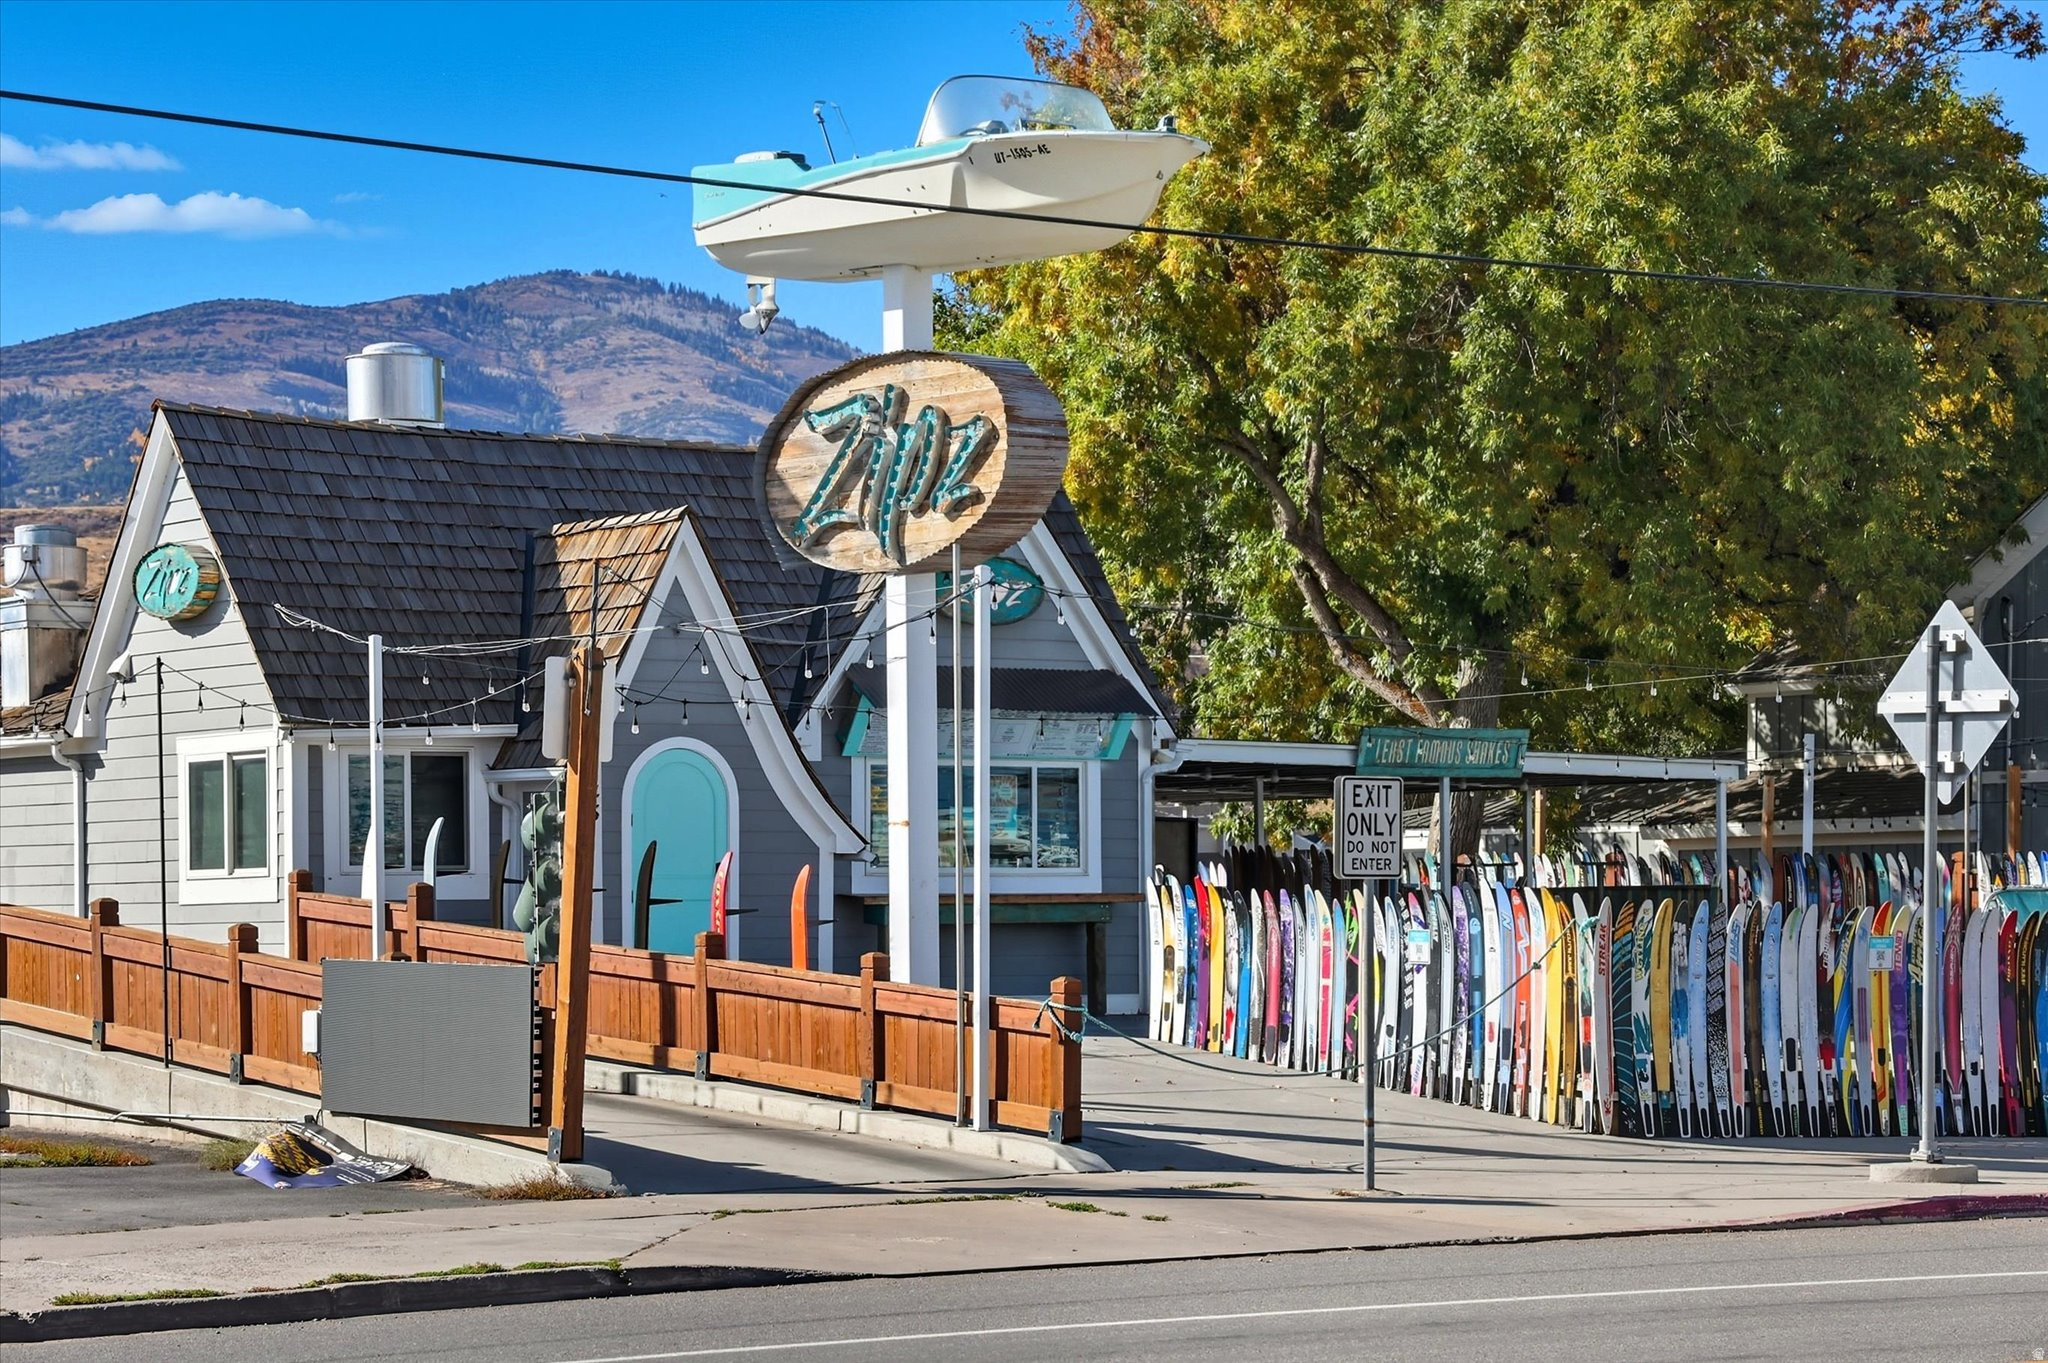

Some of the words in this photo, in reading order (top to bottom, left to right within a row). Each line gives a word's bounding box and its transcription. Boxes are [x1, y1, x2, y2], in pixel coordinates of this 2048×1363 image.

[994, 144, 1051, 164] UT-1505-AE
[1415, 738, 1463, 765] FAMOUS
[1352, 784, 1392, 808] EXIT
[1347, 812, 1397, 836] ONLY
[1347, 840, 1364, 854] DO
[1371, 840, 1396, 854] NOT
[1351, 857, 1392, 871] ENTER
[1598, 923, 1607, 977] STREAK
